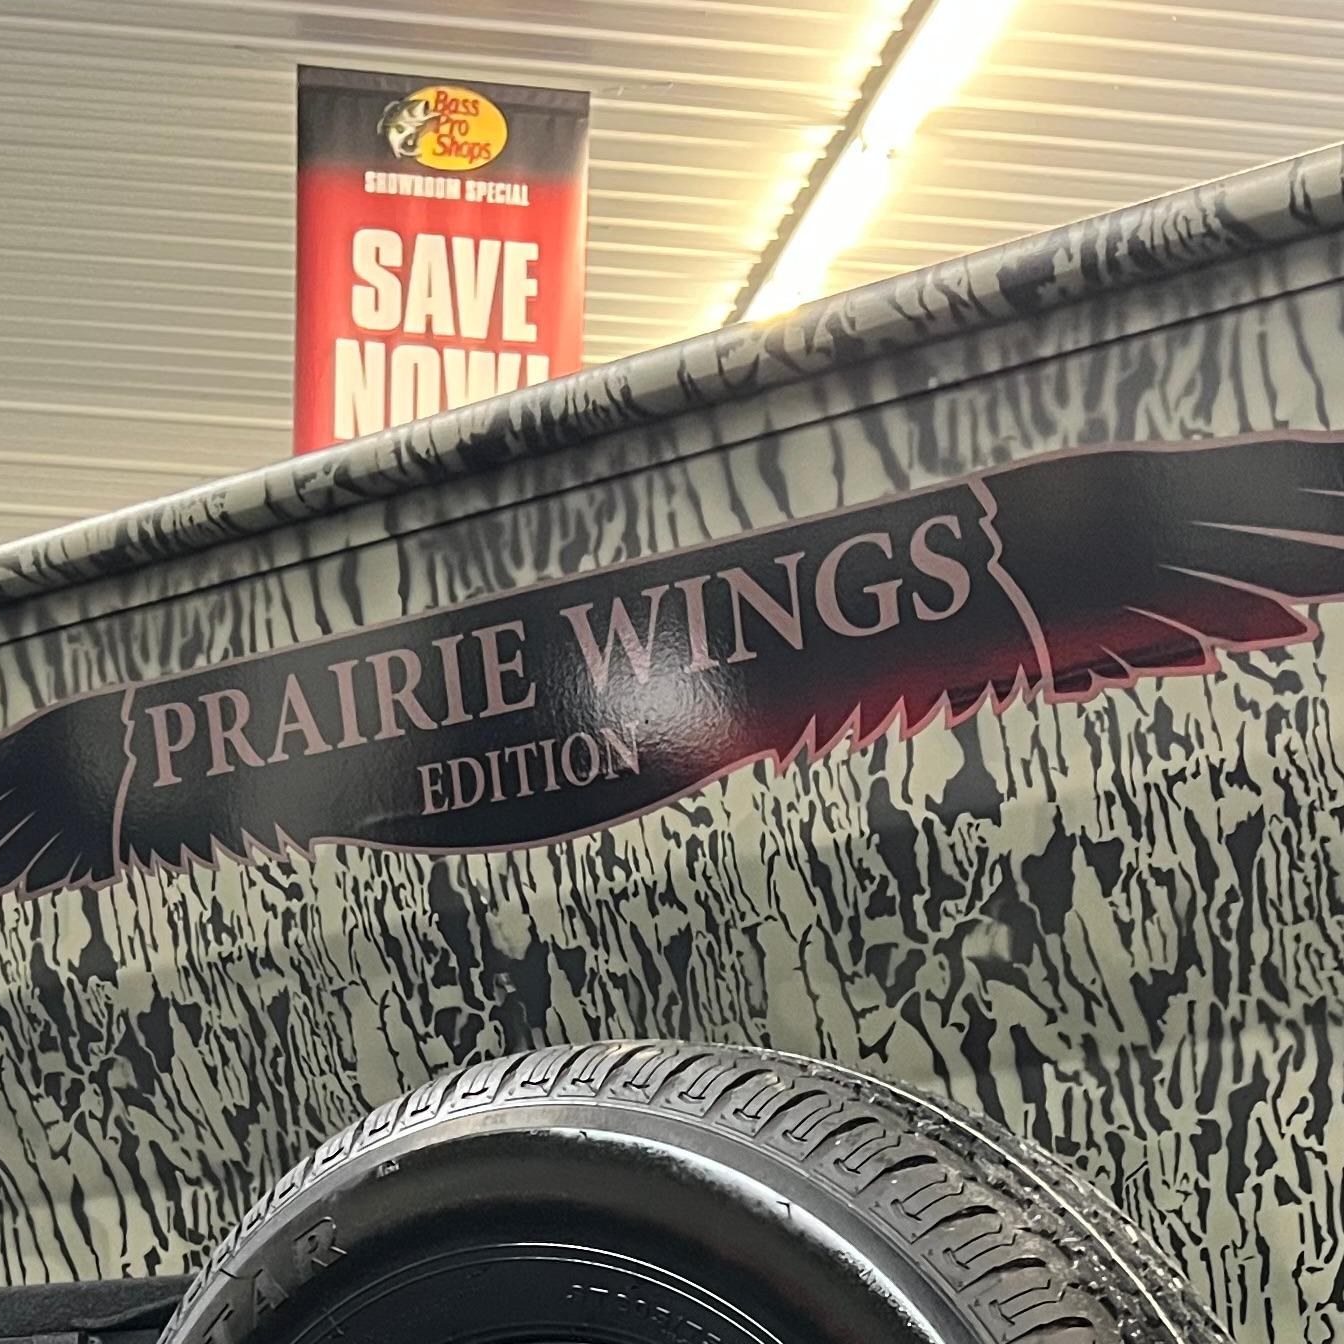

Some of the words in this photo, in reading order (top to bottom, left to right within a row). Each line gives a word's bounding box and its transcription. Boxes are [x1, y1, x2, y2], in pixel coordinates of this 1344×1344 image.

[433, 90, 480, 117] Bass
[433, 113, 469, 137] Pro
[432, 134, 492, 164] Shops
[364, 171, 462, 200] SHOWROOM
[465, 180, 531, 207] SPECIAL
[351, 227, 540, 343] SAVE
[145, 619, 539, 789] PRAIRIE
[558, 514, 973, 695] WINGS
[418, 719, 641, 816] EDITION
